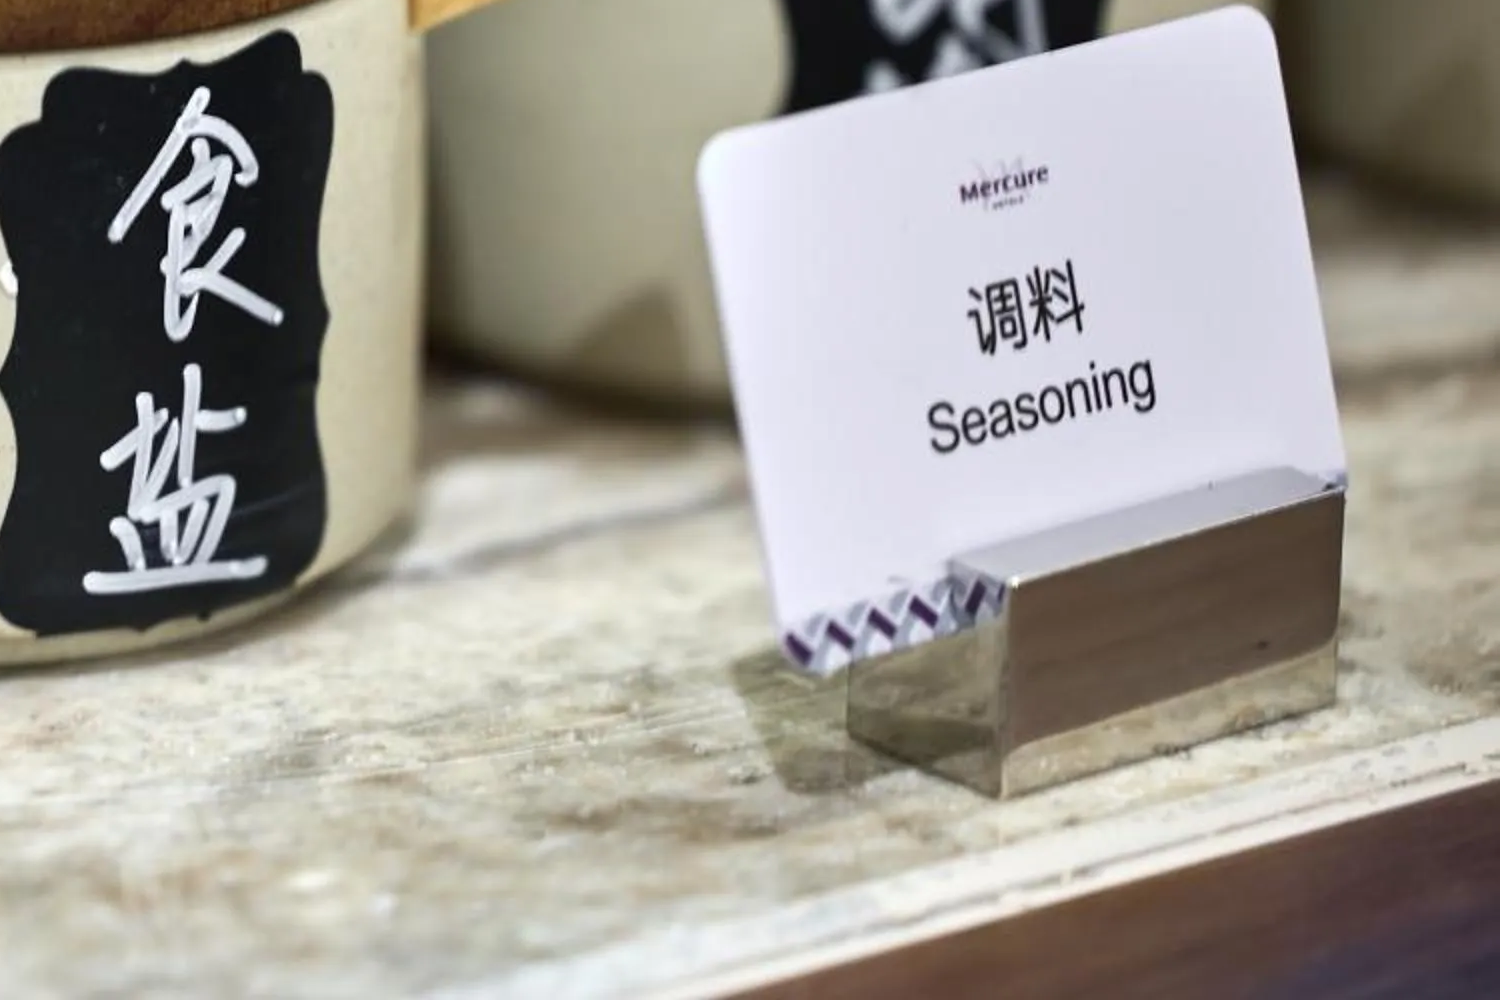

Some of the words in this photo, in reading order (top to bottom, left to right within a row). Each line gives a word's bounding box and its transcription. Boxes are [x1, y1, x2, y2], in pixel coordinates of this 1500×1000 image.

[960, 165, 1048, 204] Mercure
[83, 86, 284, 593] 食盐
[967, 258, 1085, 356] 调料
[927, 358, 1156, 454] Seasoning
